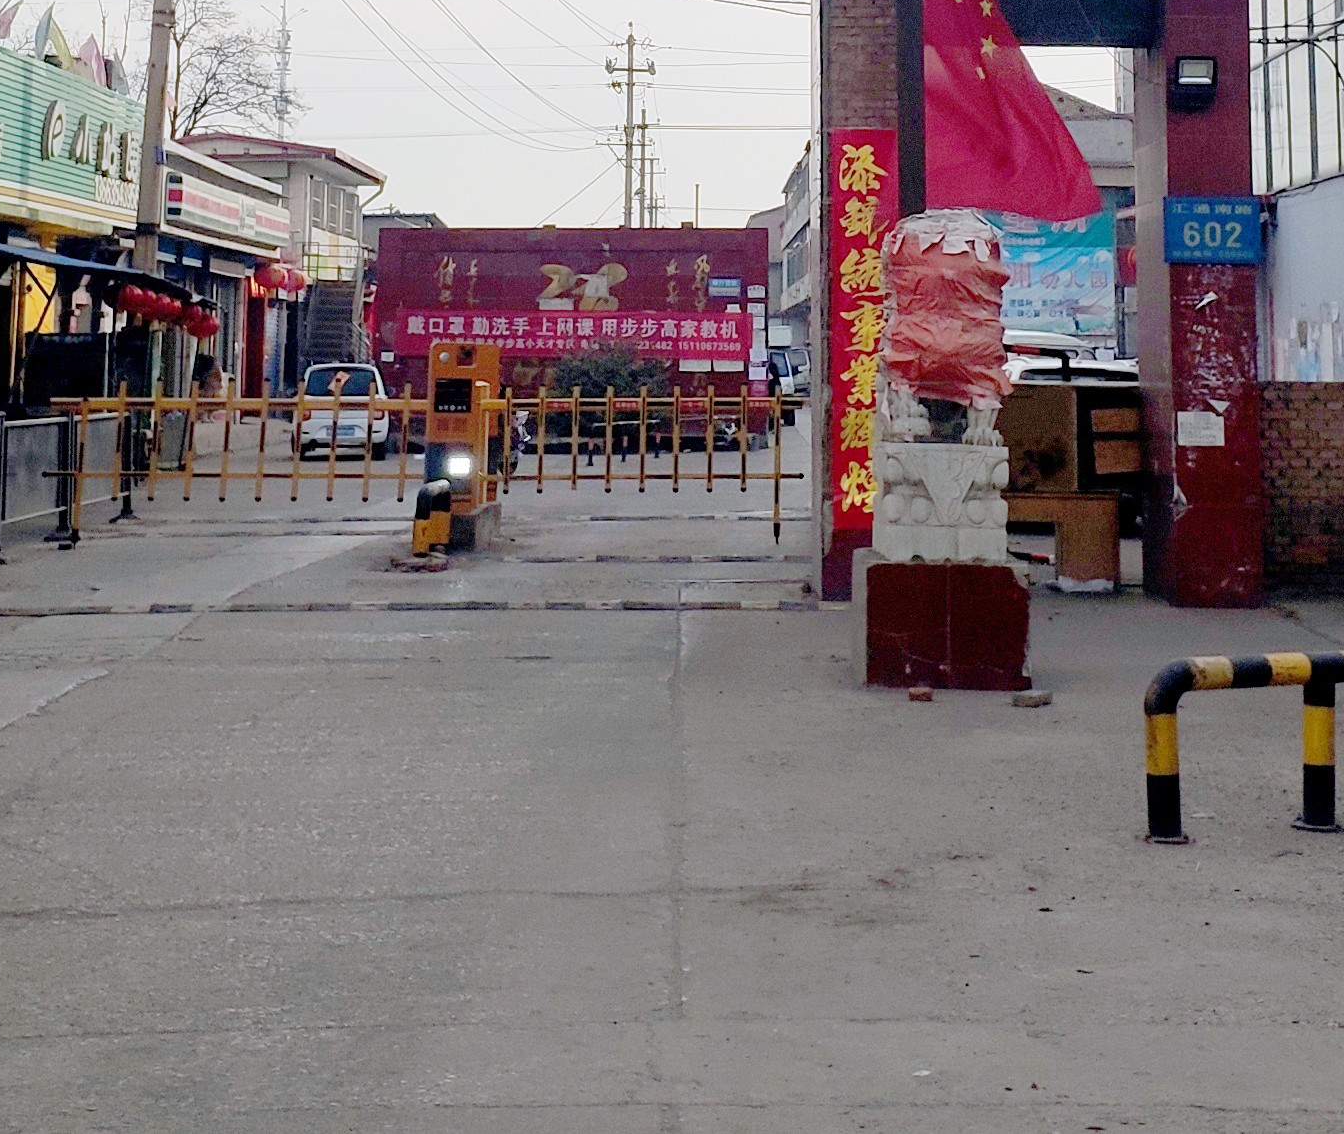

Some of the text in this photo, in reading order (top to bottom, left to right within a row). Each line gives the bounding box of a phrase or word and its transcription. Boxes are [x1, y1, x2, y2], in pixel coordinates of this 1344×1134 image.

[1183, 221, 1243, 248] 602
[407, 316, 739, 339] 戴口罩 勤洗手 上网课 用步步高家教机
